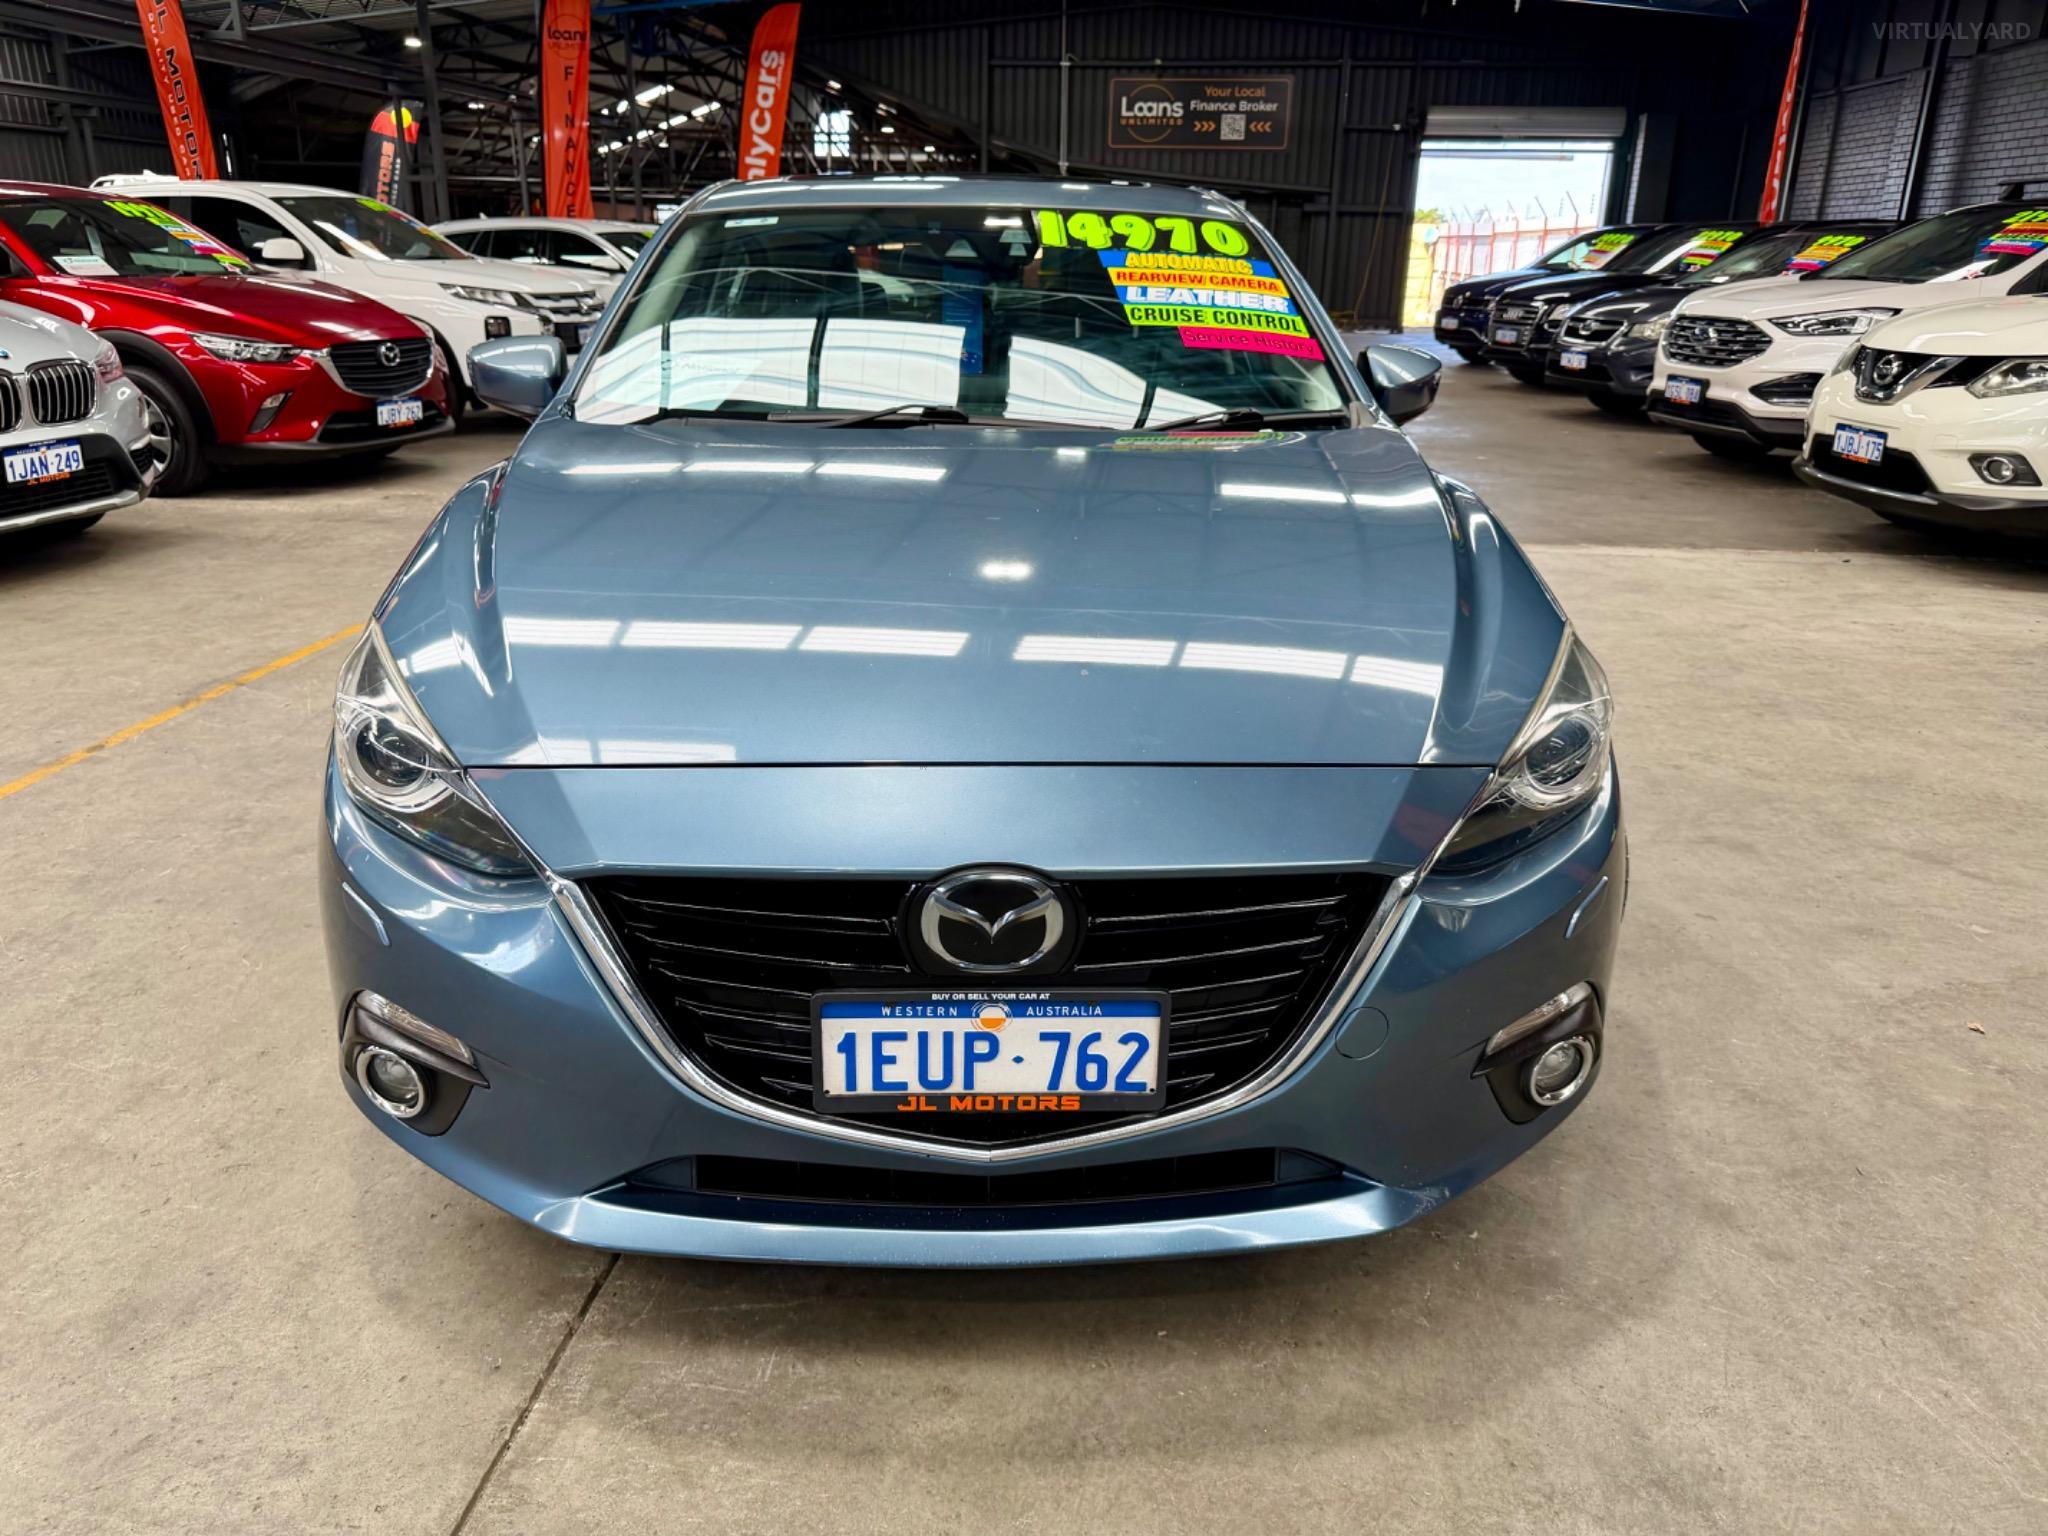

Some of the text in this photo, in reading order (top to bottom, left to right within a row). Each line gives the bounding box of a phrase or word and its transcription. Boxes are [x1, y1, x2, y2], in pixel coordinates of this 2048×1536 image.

[1204, 86, 1266, 98] Your Local
[1121, 96, 1184, 117] Loans
[1190, 100, 1278, 112] Finance Broker
[1120, 118, 1184, 126] UNLIMITED
[564, 66, 577, 218] FINANCE
[1036, 210, 1249, 256] 14970
[1125, 252, 1253, 275] AUTOMATIC
[1209, 276, 1280, 292] CAMERA
[1126, 286, 1290, 313] LEATHER
[1130, 307, 1303, 333] CRUISE CONTROL
[1185, 330, 1315, 355] Service History
[931, 993, 1051, 1001] BUY OR SELL YOUR CAR AT
[881, 1006, 1103, 1017] WESTERN AUSTRALIA
[897, 1095, 1081, 1111] JL MOTORS
